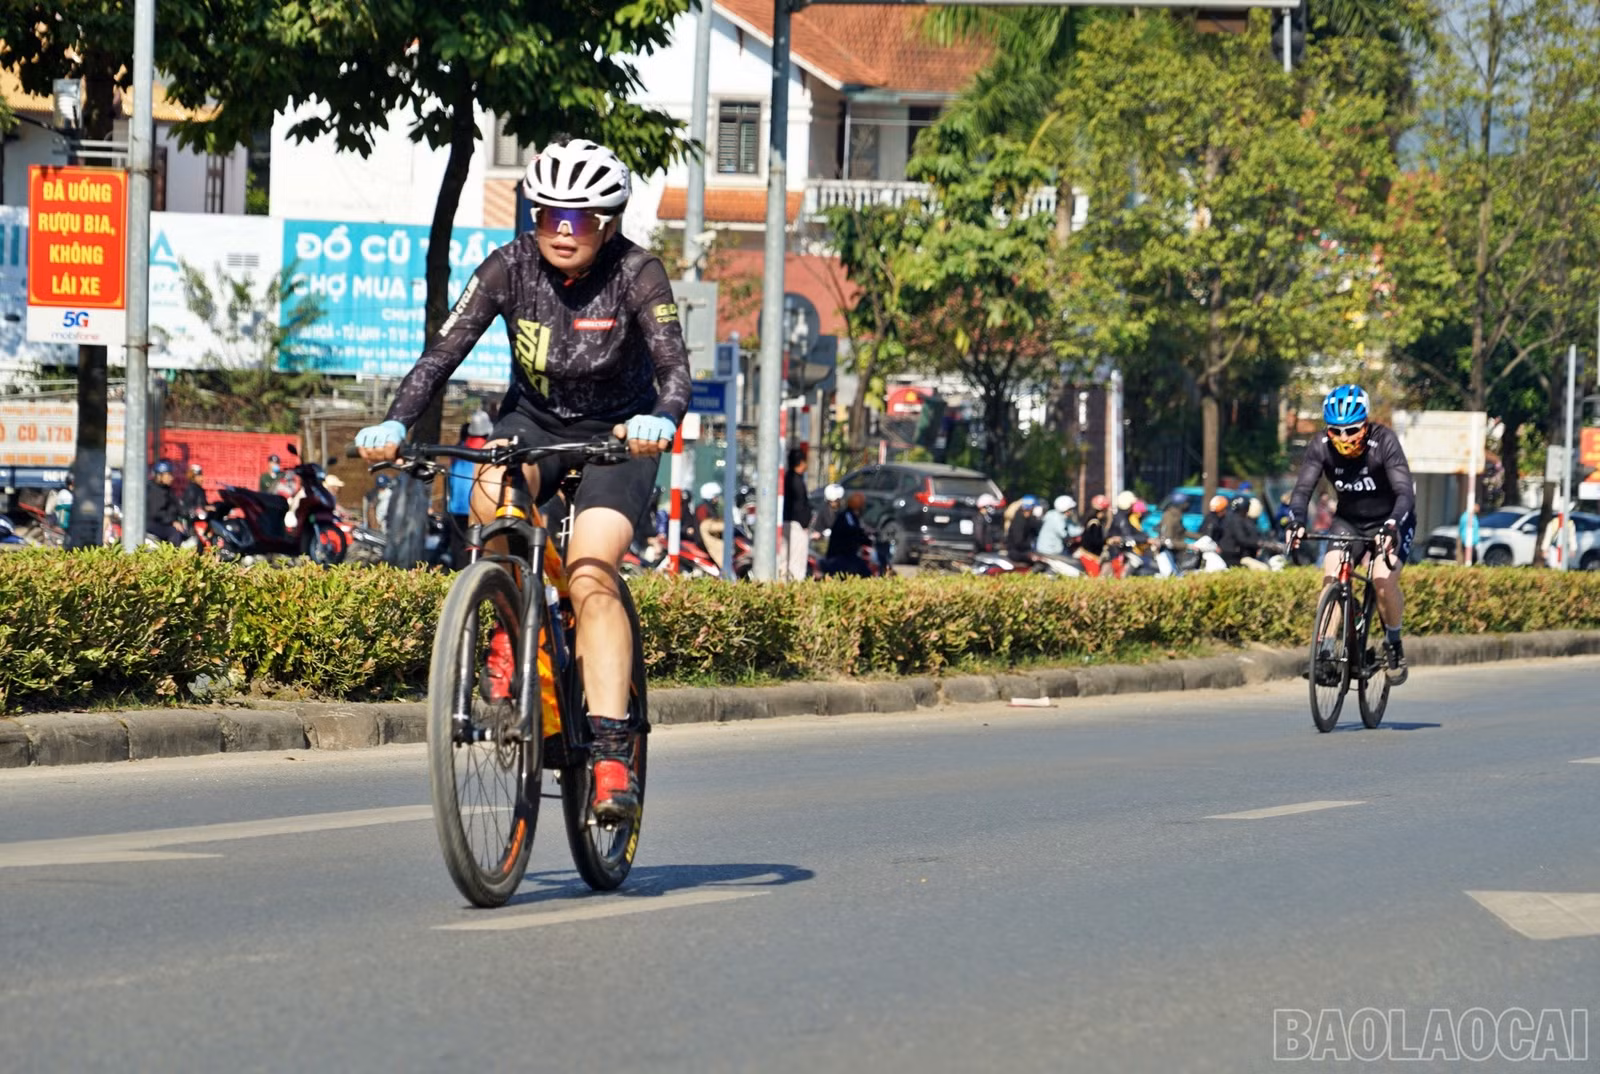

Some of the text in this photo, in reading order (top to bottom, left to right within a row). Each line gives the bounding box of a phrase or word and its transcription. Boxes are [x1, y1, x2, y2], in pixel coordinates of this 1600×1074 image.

[43, 176, 112, 203] ĐÃ UỐNG
[38, 211, 116, 236] RƯỢU BIA,
[49, 240, 104, 265] KHÔNG
[361, 230, 411, 264] CŨ
[52, 272, 101, 295] LÁI XE
[292, 271, 347, 304] CHỢ
[352, 273, 407, 300] MUA
[63, 311, 89, 328] 5G
